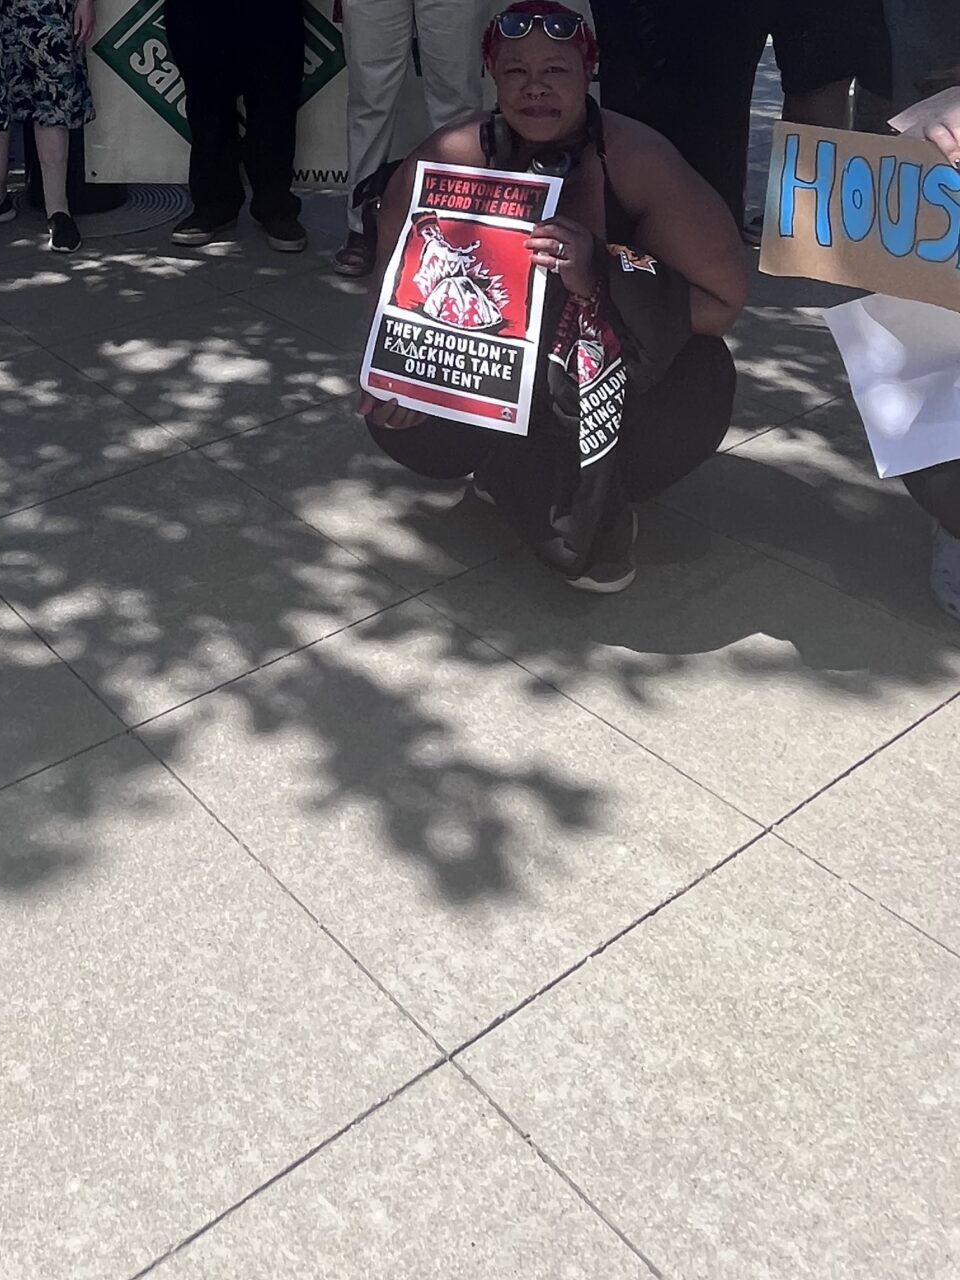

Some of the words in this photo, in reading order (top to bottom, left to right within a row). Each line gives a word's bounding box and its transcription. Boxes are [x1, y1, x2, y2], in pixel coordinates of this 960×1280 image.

[425, 175, 438, 190] IF
[439, 179, 502, 199] EVERYONE
[503, 186, 541, 203] CAN'T
[426, 192, 472, 210] AFFORD
[472, 198, 499, 213] THE
[499, 201, 534, 218] RENT
[779, 134, 960, 269] HOUS
[385, 319, 423, 341] THEY
[424, 329, 518, 364] SHOULDN'T
[404, 358, 437, 379] OUR
[441, 368, 482, 391] TENT
[470, 357, 513, 381] TAKE
[580, 365, 628, 417] HOULDN'
[579, 400, 617, 439] CKING
[580, 428, 608, 455] OUR
